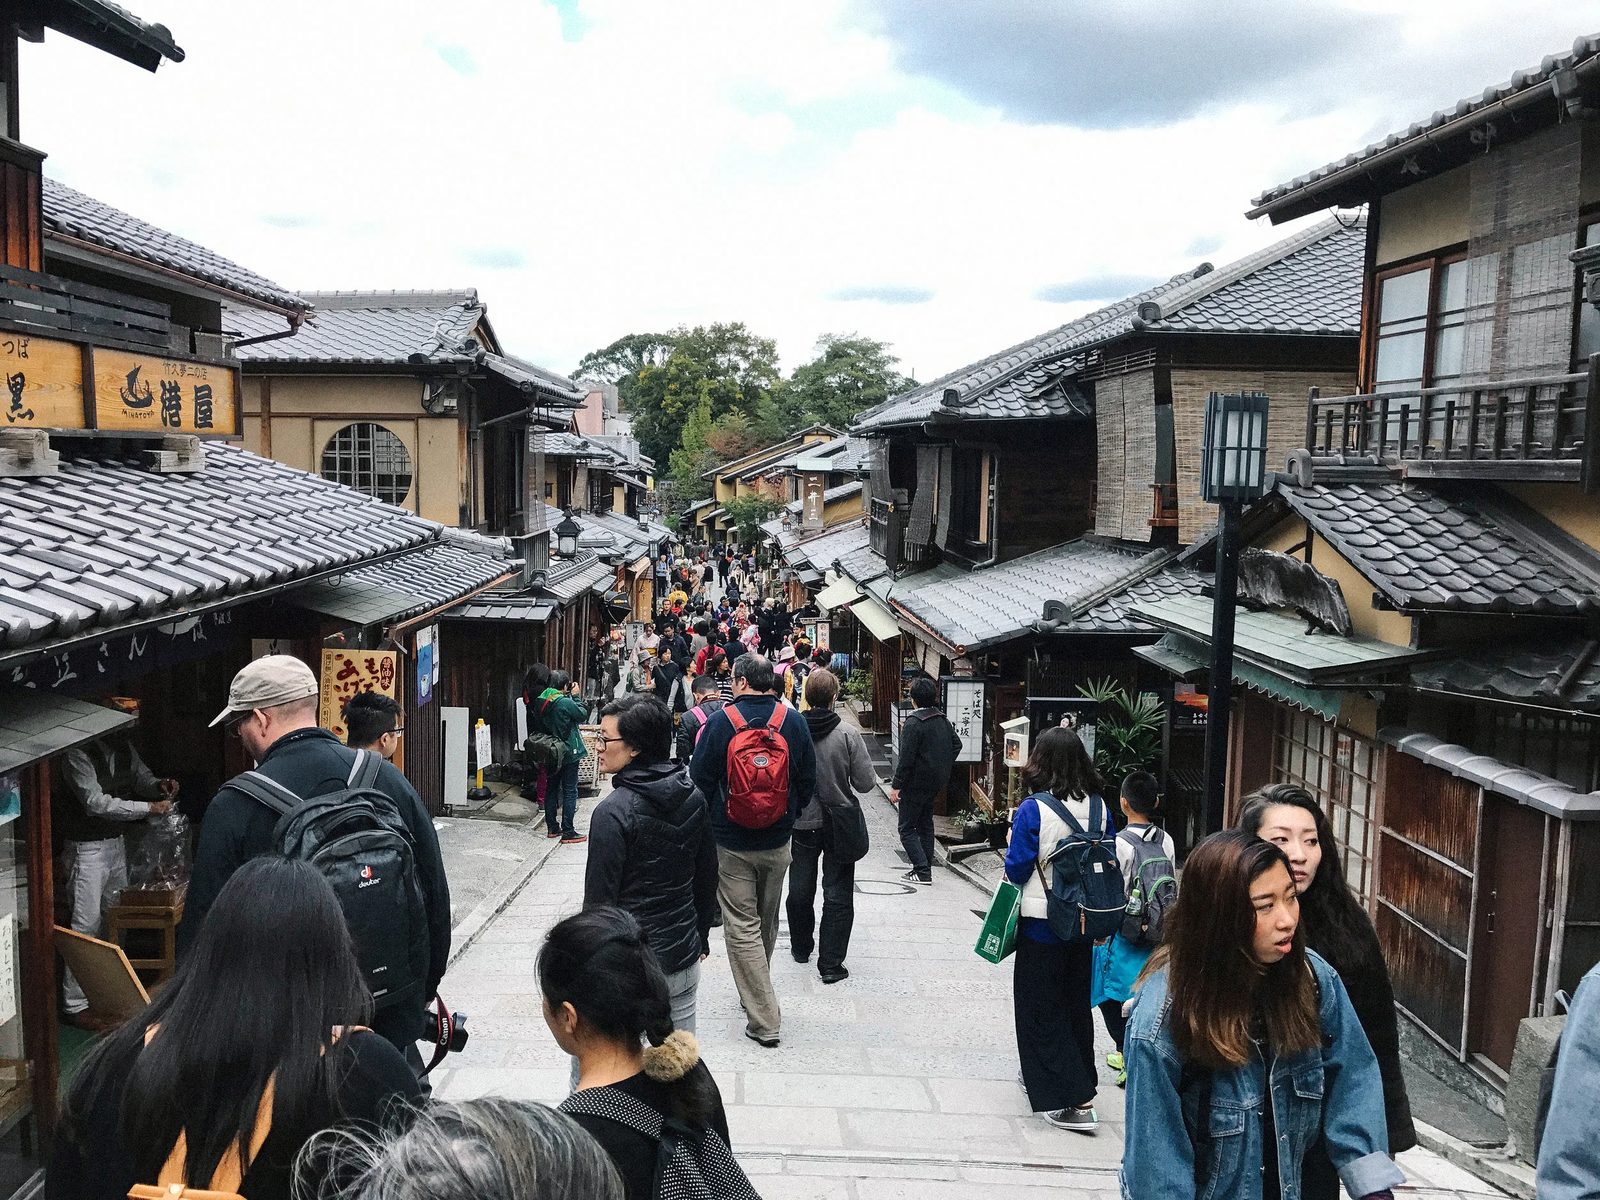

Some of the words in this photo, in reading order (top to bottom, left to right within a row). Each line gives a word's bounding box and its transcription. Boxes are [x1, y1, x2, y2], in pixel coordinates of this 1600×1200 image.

[162, 361, 208, 380] 竹久夢二の店
[121, 408, 154, 418] MINATOYA
[160, 379, 213, 428] 港屋
[972, 689, 981, 719] そば処
[358, 877, 381, 888] deuter
[440, 1017, 449, 1046] Canon
